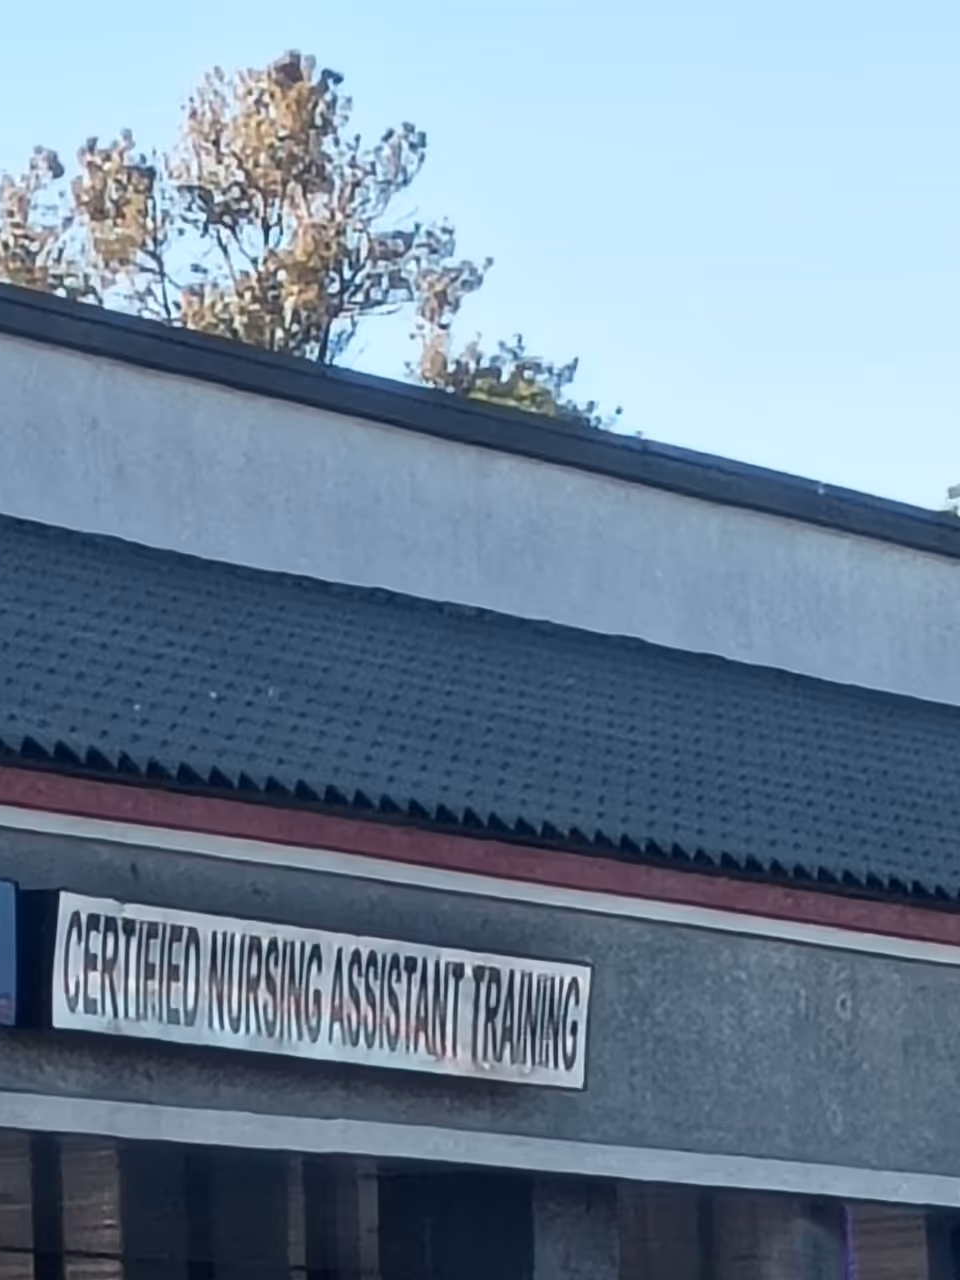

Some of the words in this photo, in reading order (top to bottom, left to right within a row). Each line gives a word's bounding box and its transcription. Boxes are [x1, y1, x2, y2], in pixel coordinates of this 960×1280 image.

[62, 908, 202, 1028] CERTIFIED
[206, 929, 323, 1046] NURSING
[328, 946, 466, 1060] ASSISTANT
[470, 963, 582, 1073] TRAINING
